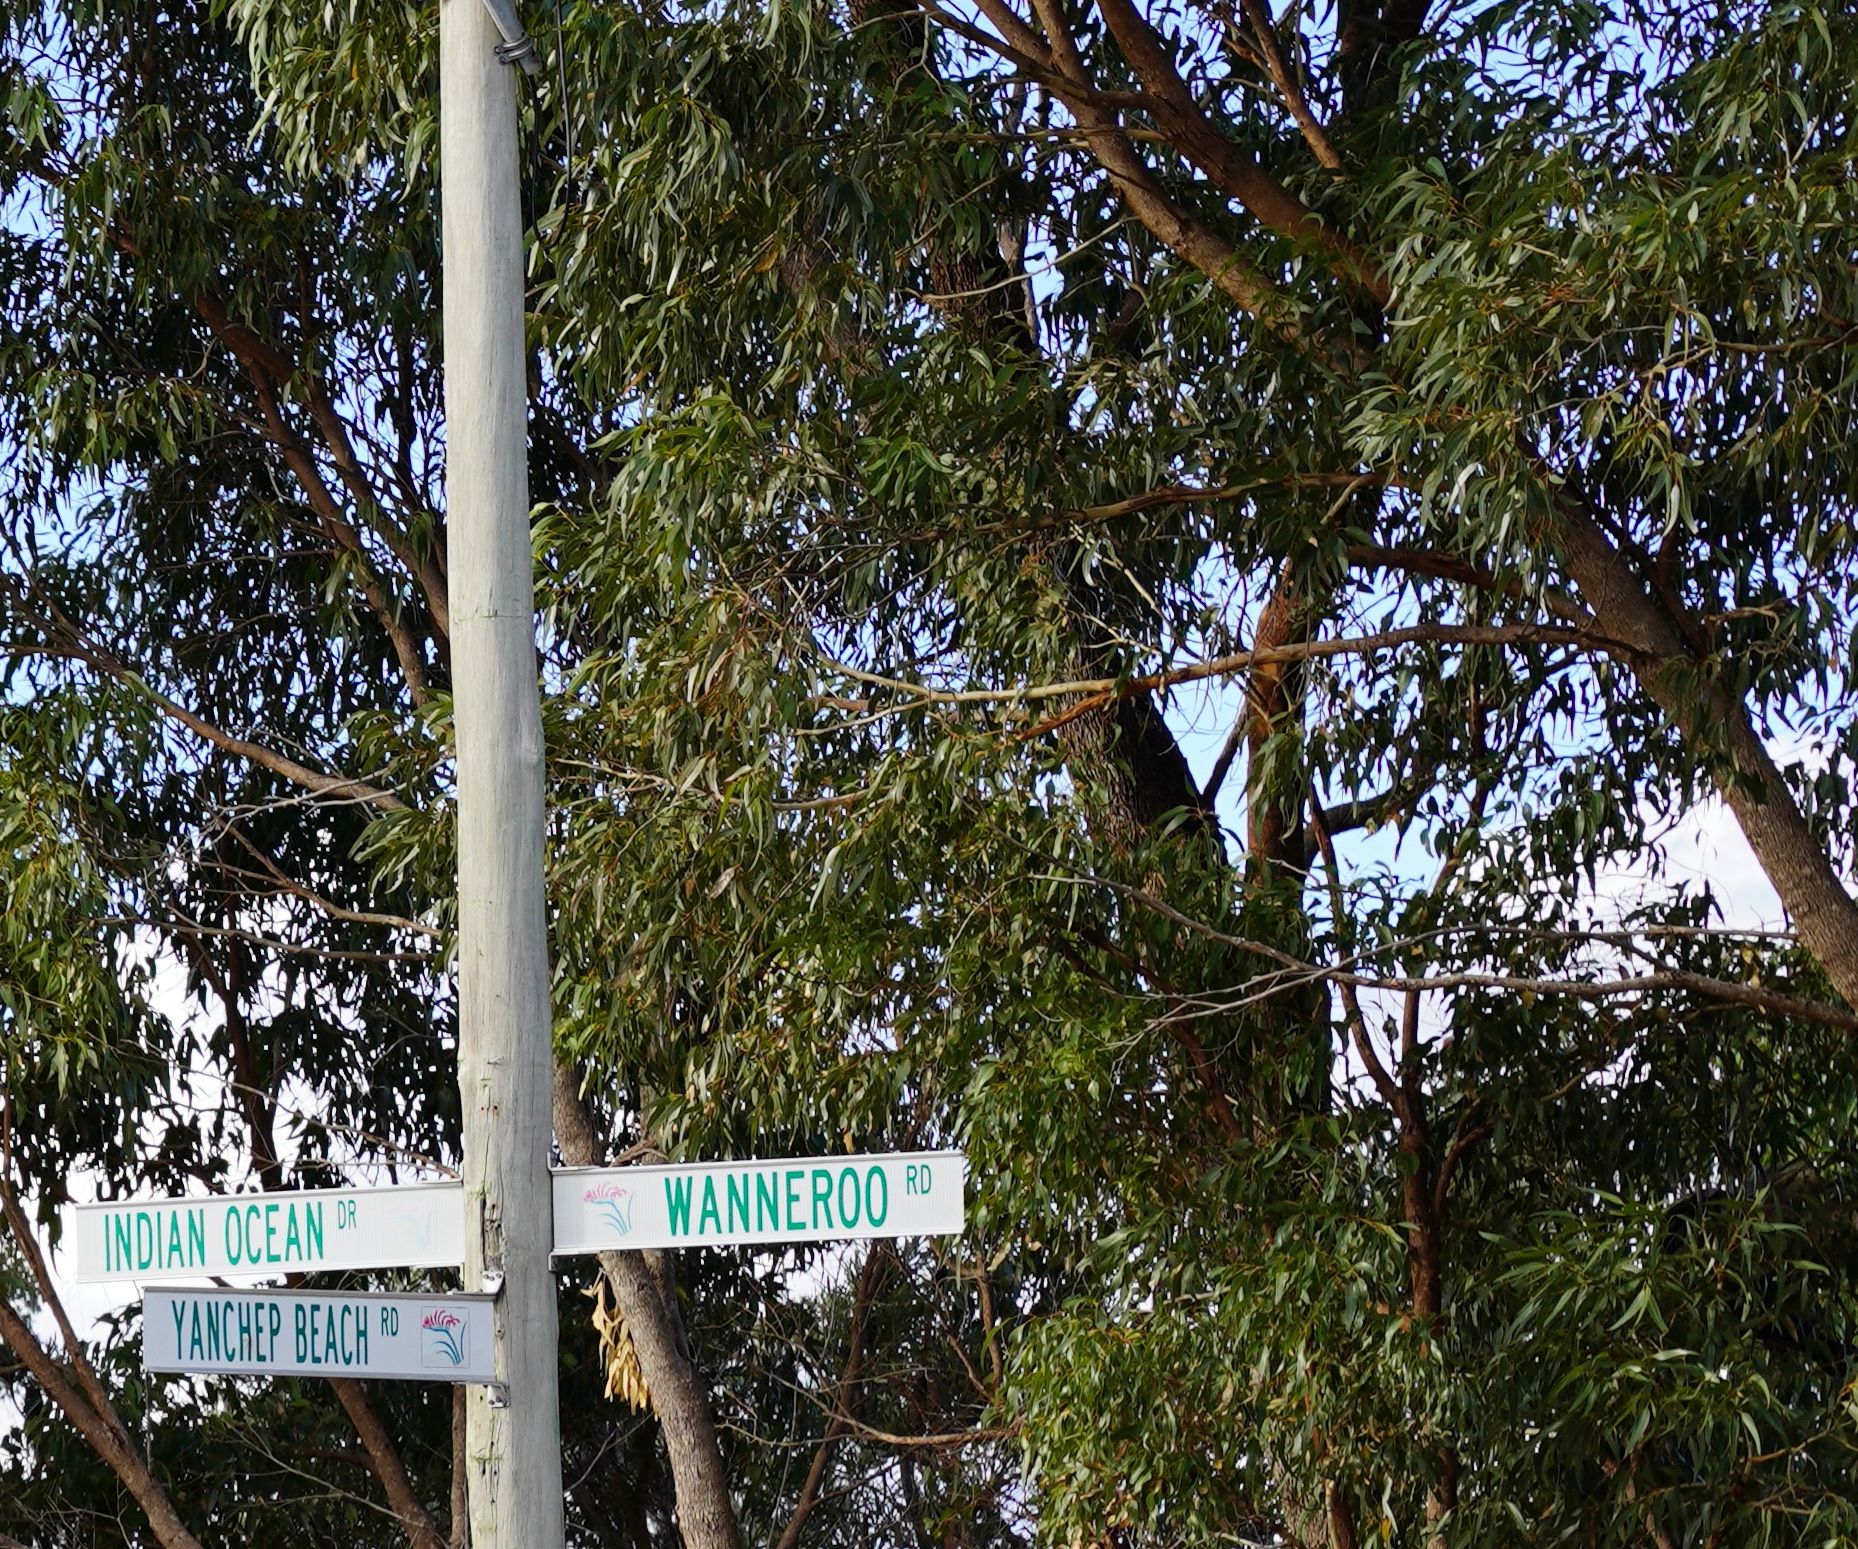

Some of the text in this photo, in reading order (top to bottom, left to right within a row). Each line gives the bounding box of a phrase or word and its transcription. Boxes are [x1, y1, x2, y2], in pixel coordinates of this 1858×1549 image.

[104, 1199, 358, 1273] INDIAN OCEAN DR
[664, 1163, 933, 1237] WANNEROO RD
[171, 1298, 400, 1367] YANCHEP BEACH RD
